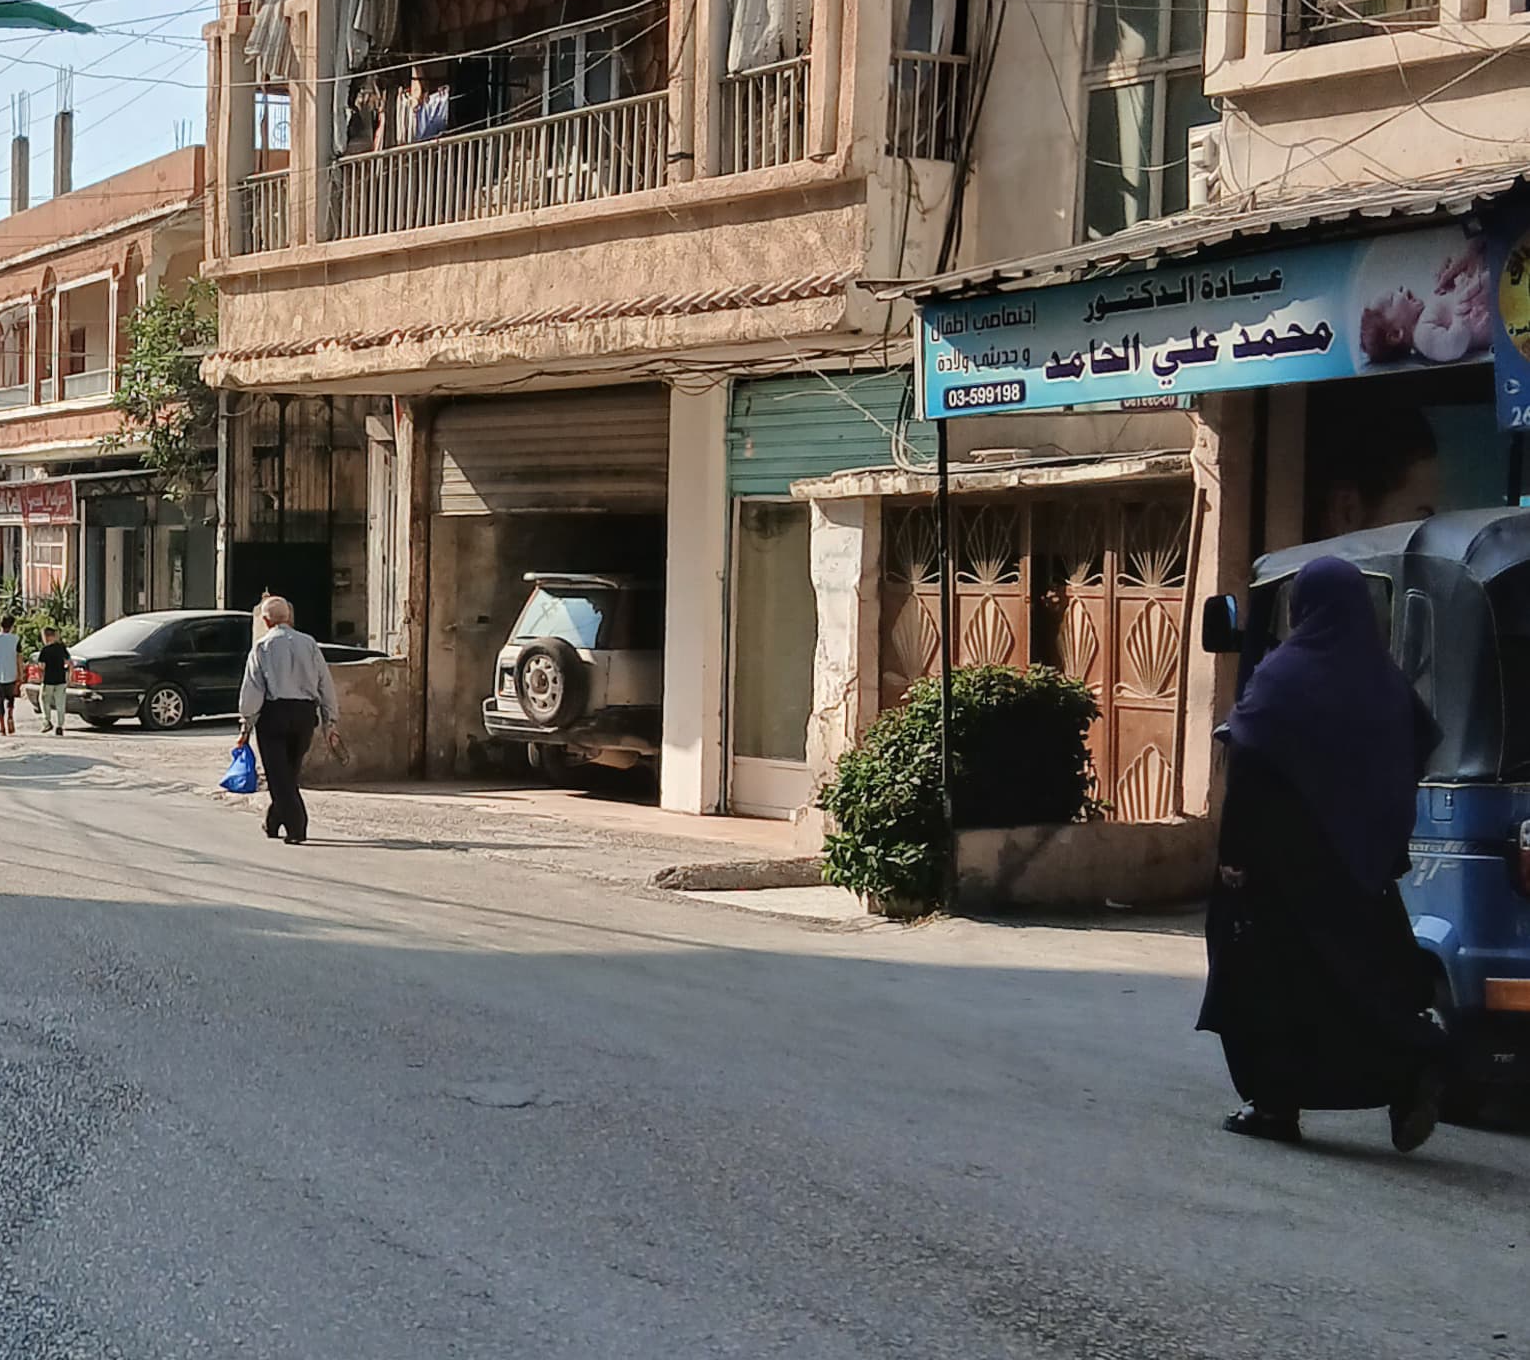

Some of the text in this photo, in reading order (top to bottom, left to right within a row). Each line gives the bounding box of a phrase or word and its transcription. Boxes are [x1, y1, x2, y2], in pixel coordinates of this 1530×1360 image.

[1082, 267, 1284, 324] عيادة الدكتور
[931, 312, 969, 342] اطفال
[937, 348, 970, 375] ولادة
[1044, 321, 1334, 387] محمد علي الحامد
[948, 383, 1021, 408] 03-599198
